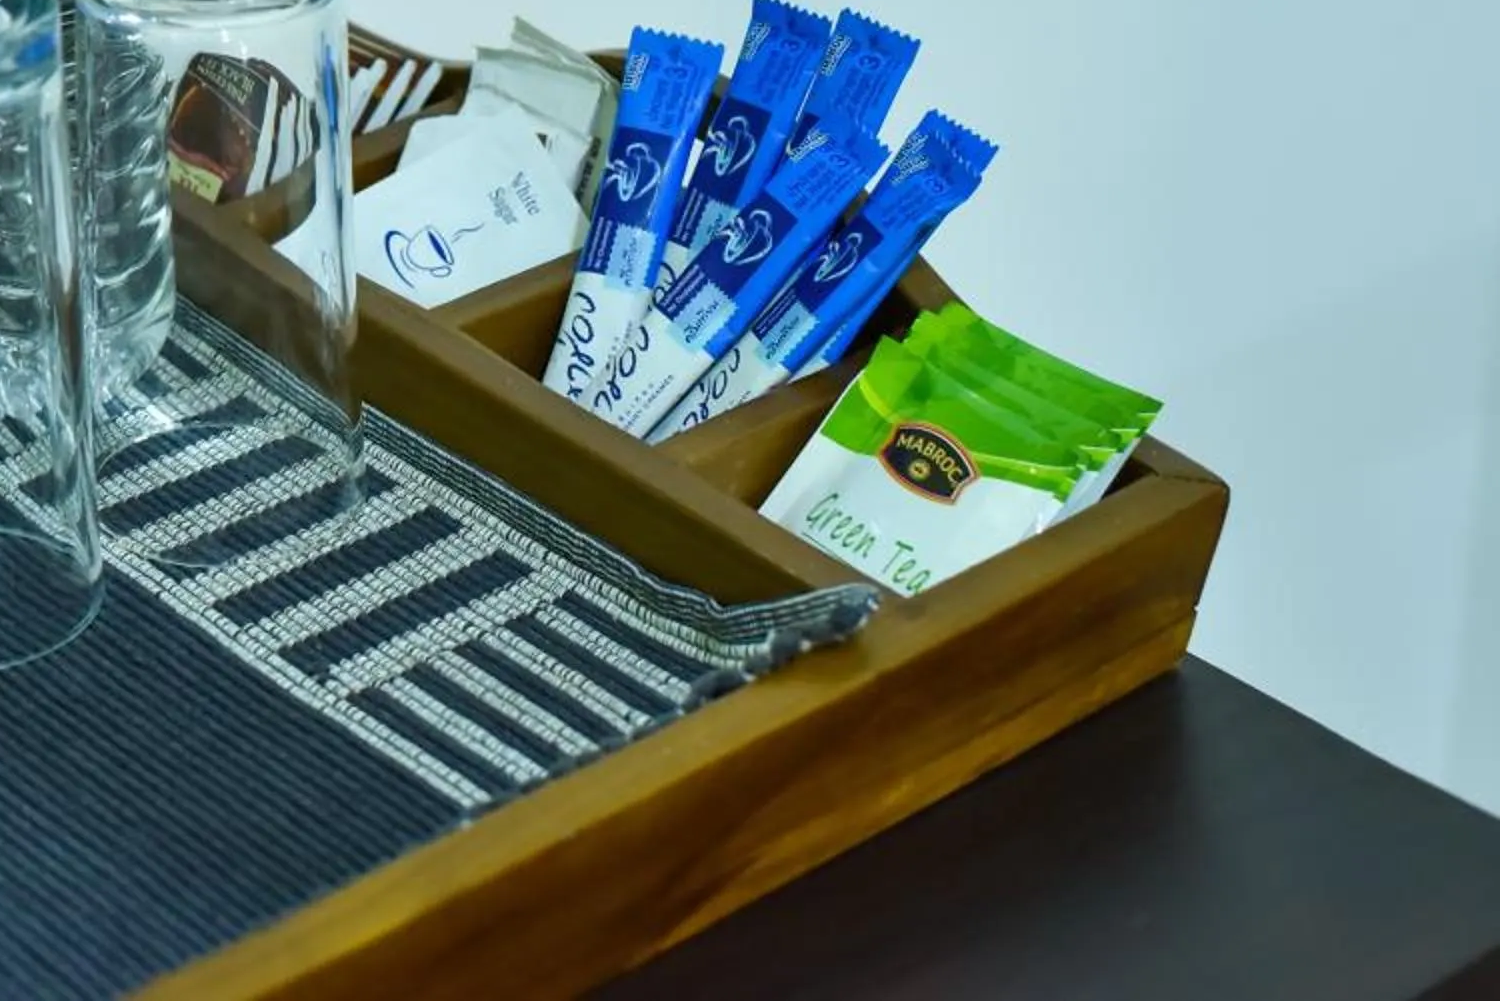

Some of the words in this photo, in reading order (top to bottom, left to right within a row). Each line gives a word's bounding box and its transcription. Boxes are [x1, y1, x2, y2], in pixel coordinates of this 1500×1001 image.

[512, 171, 540, 216] White
[897, 434, 964, 487] MABROC
[805, 493, 877, 559] Green
[882, 542, 931, 593] Tea
